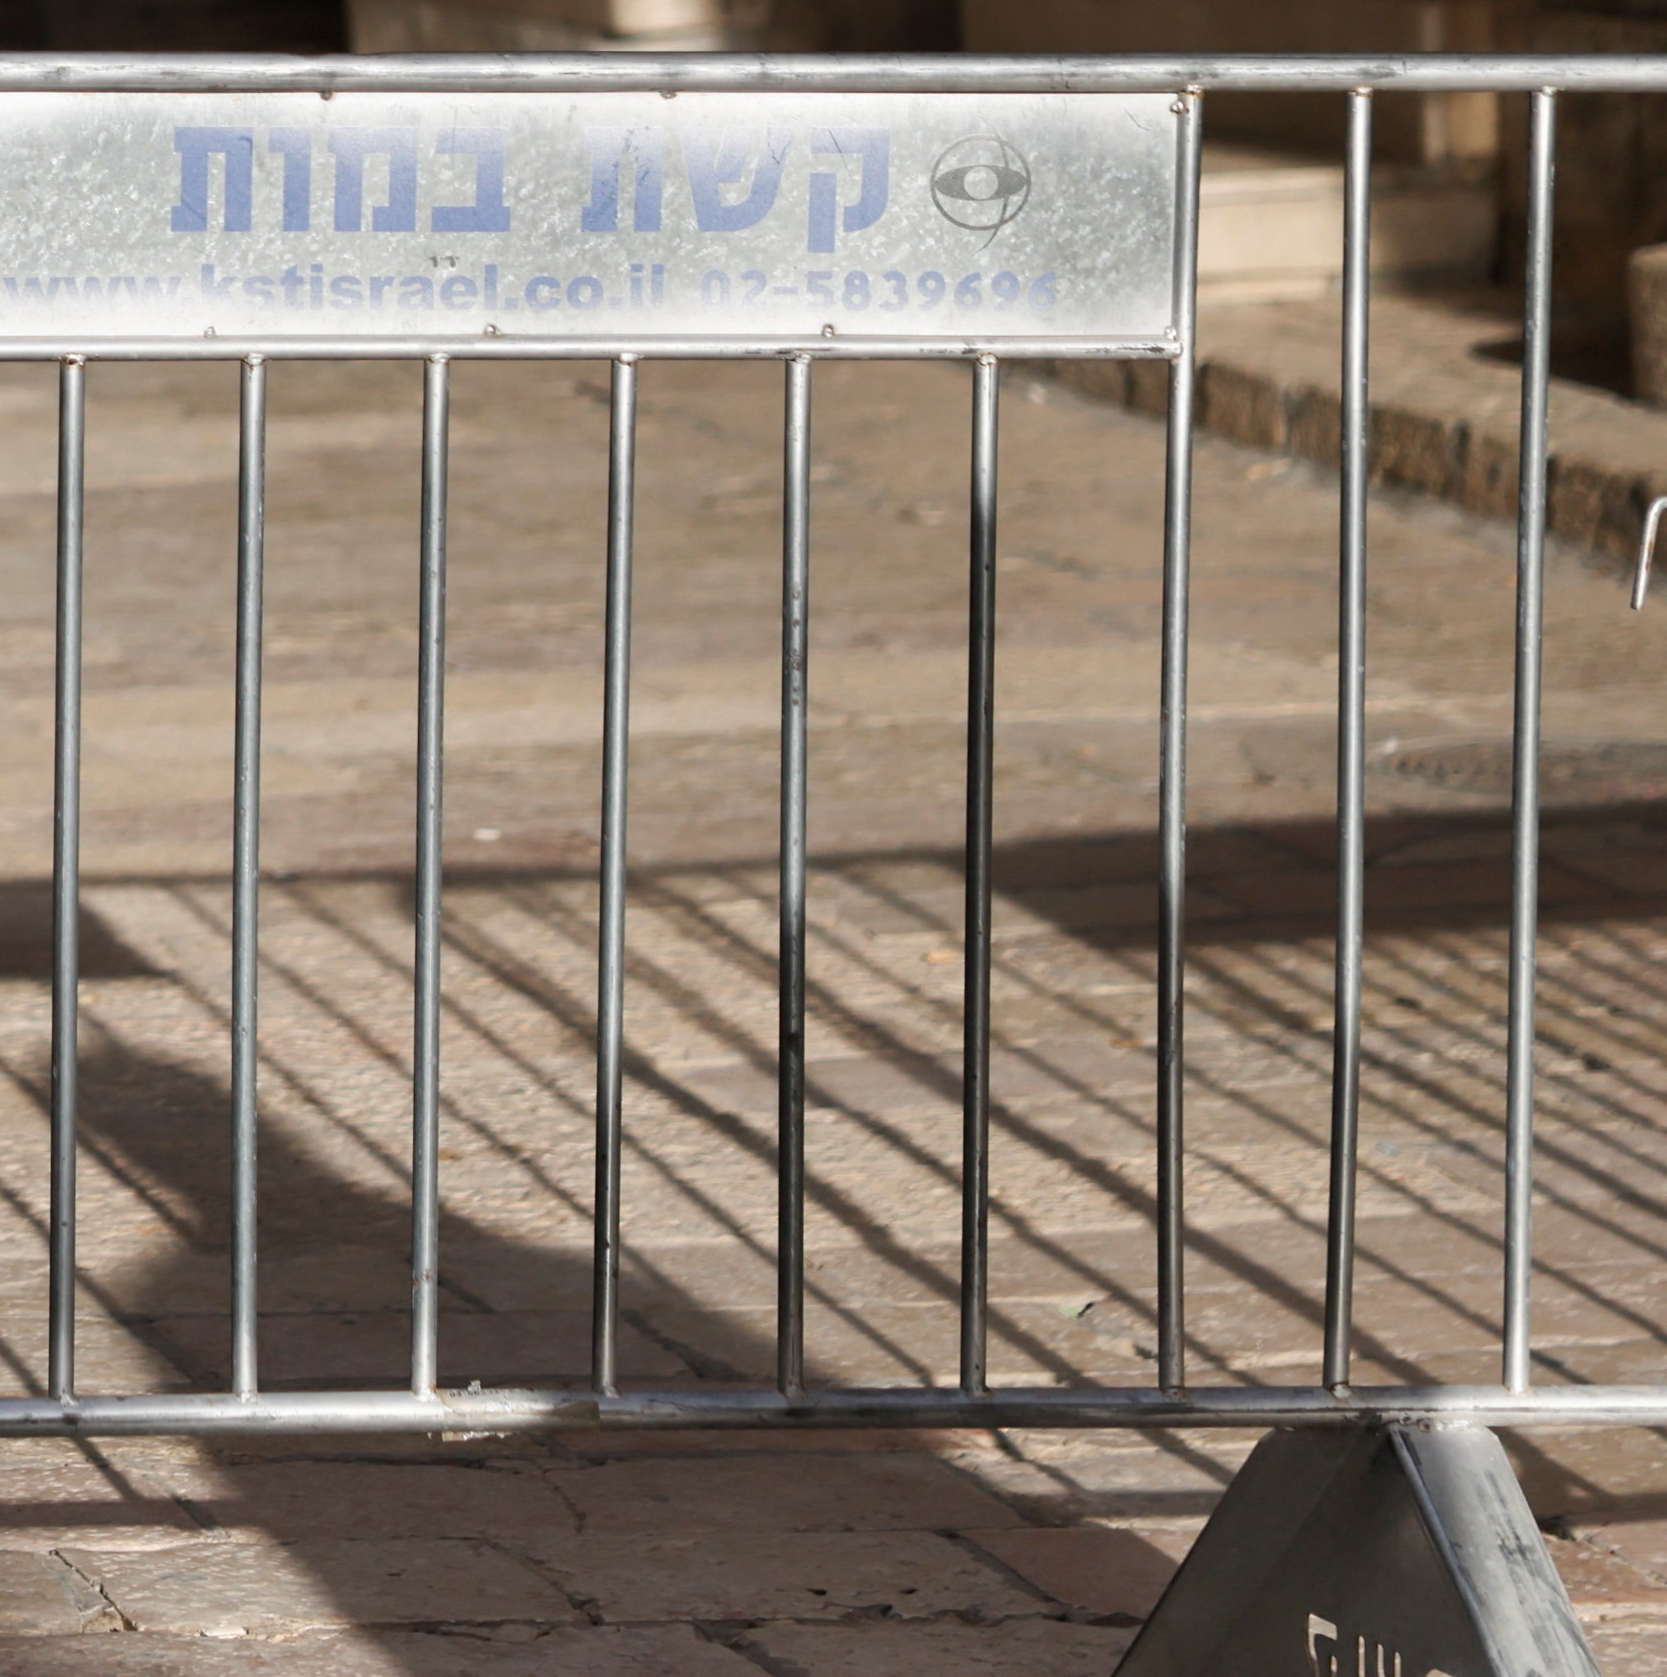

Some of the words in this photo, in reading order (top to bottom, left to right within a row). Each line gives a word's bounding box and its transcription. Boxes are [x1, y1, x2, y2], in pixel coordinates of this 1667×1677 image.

[169, 125, 512, 233] במות
[579, 126, 893, 254] קשת
[2, 263, 665, 313] www.kstisrael.co.il
[699, 268, 1058, 314] 02-5839696
